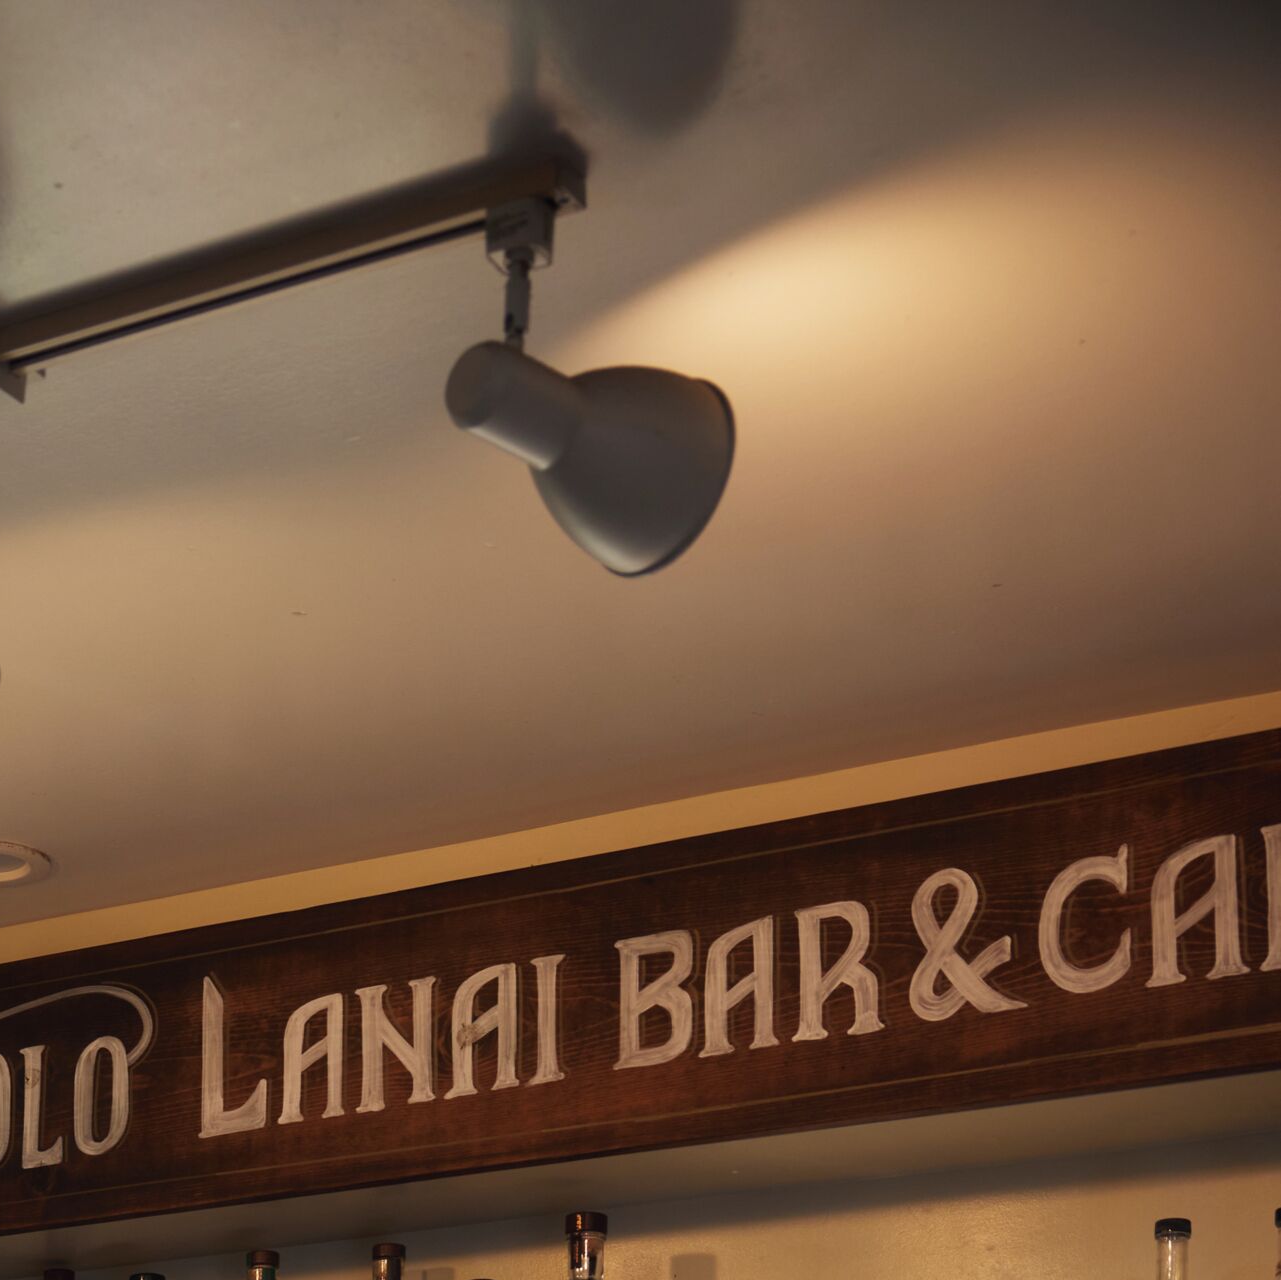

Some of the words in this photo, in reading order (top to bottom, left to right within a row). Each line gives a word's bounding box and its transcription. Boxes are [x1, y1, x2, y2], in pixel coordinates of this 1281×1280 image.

[199, 953, 568, 1138] LANAI
[614, 899, 886, 1071] BAR
[909, 866, 1030, 1022] &
